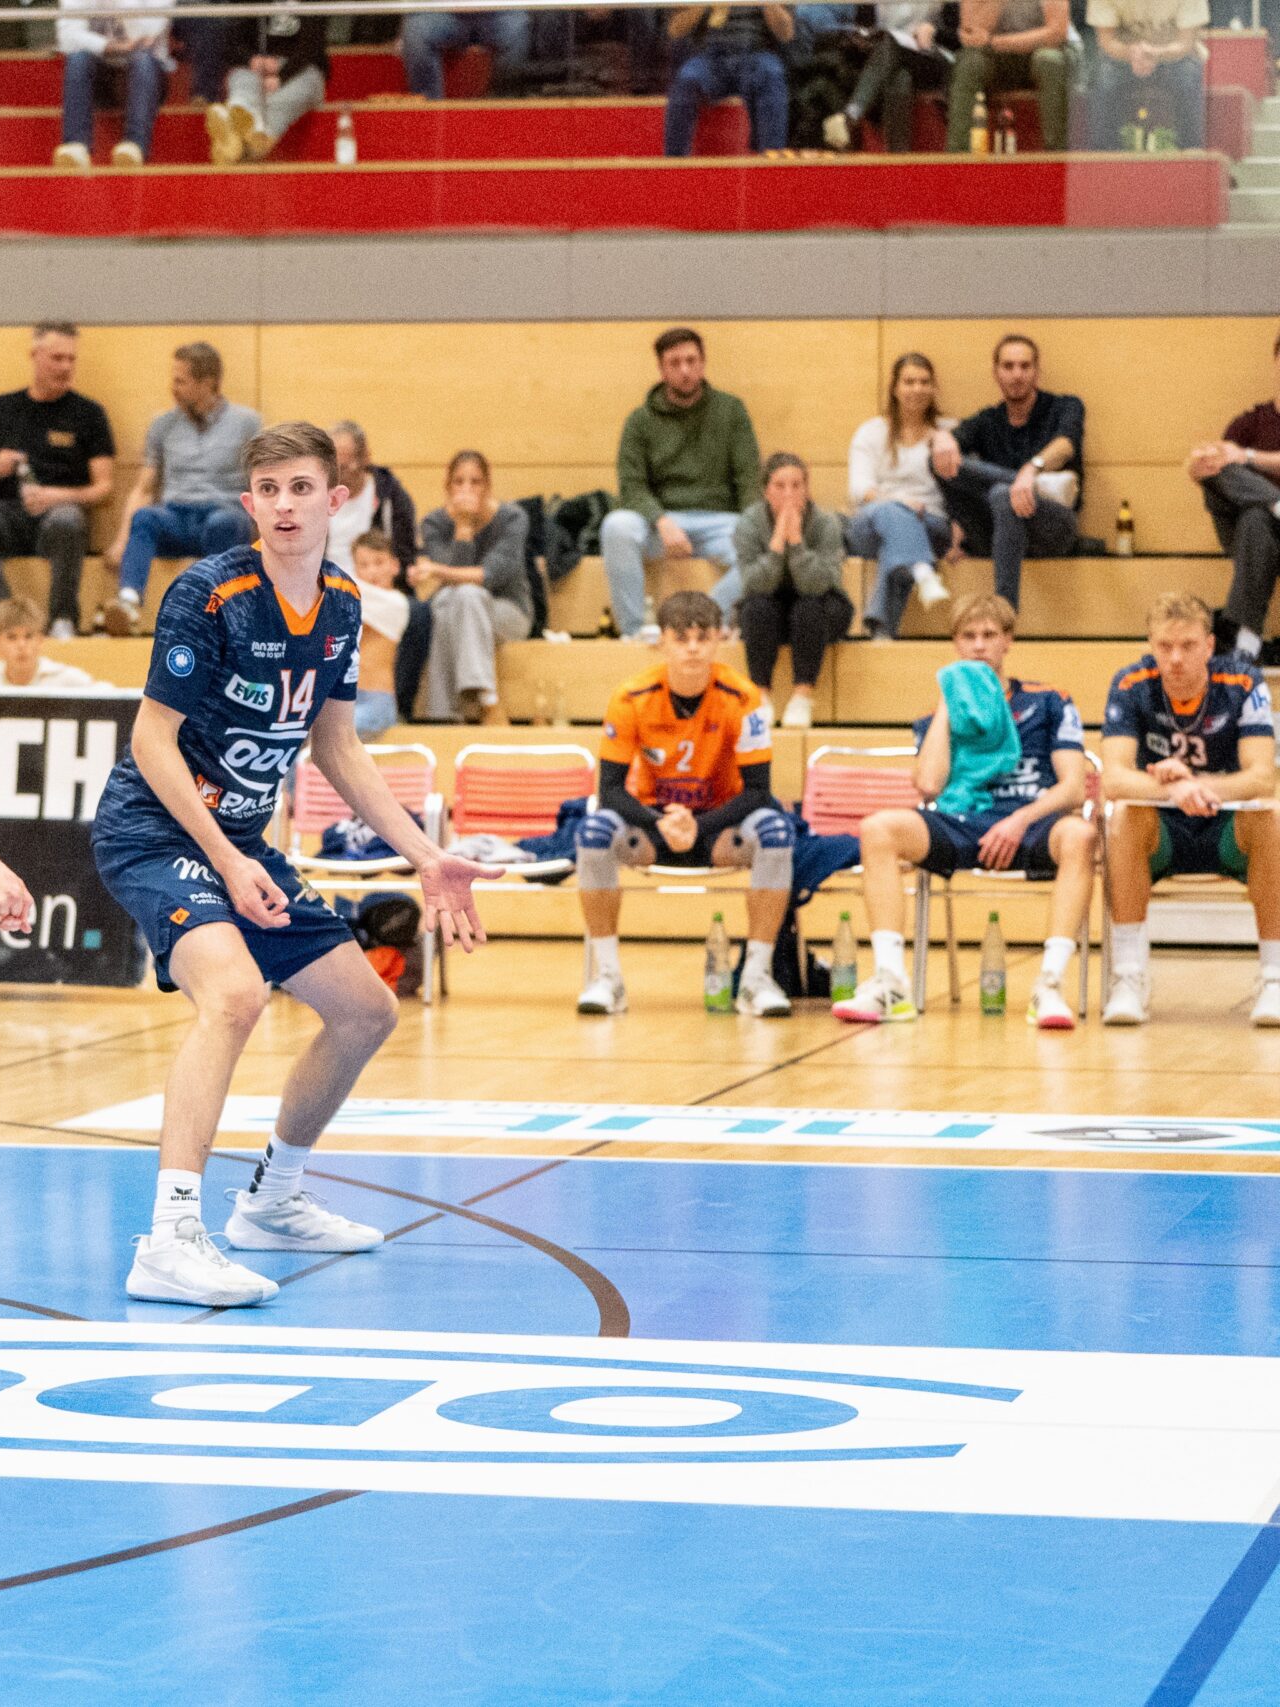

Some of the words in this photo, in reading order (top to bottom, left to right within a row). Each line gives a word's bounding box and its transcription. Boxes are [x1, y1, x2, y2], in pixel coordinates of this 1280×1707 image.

[232, 681, 271, 706] EVIS
[279, 668, 317, 722] 14
[676, 740, 695, 772] 2
[1171, 732, 1208, 767] 23
